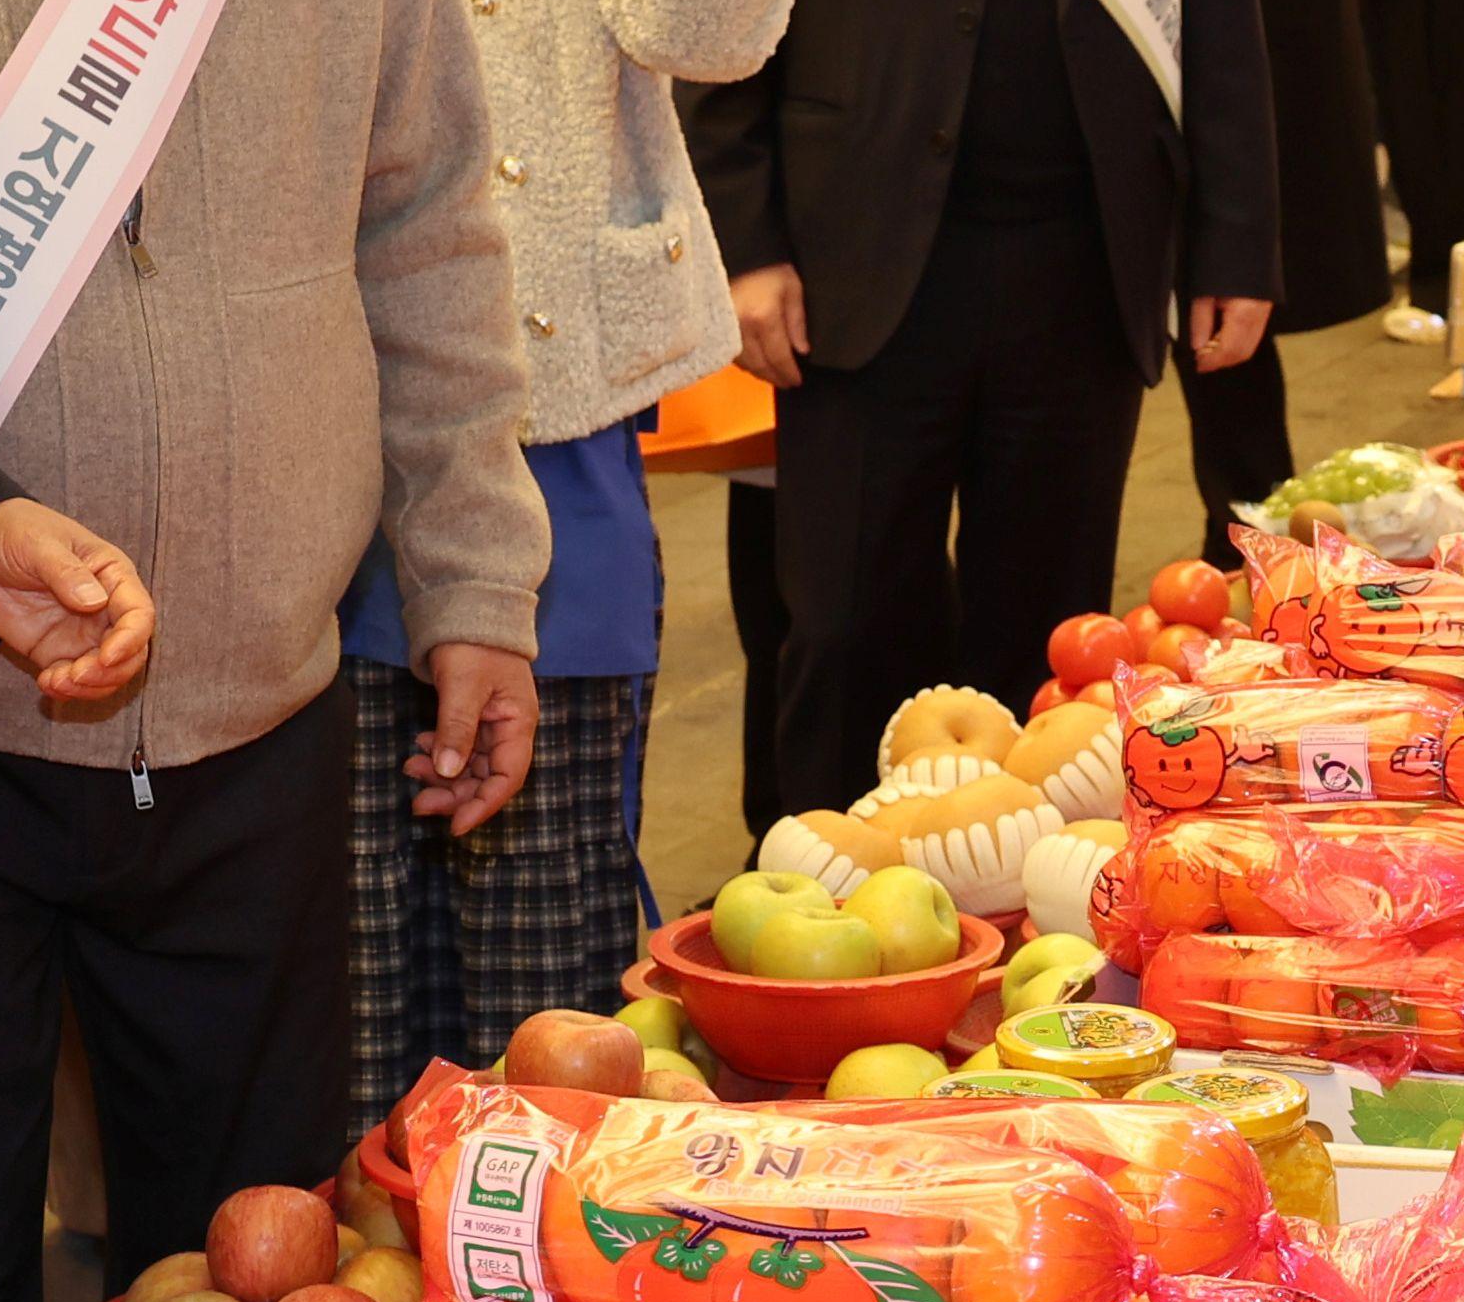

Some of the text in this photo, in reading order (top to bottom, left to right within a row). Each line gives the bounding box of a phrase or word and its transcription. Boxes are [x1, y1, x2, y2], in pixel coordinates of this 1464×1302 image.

[485, 1157, 522, 1176] GAP
[473, 1219, 512, 1237] 1005867
[474, 1255, 516, 1278] 저탄소
